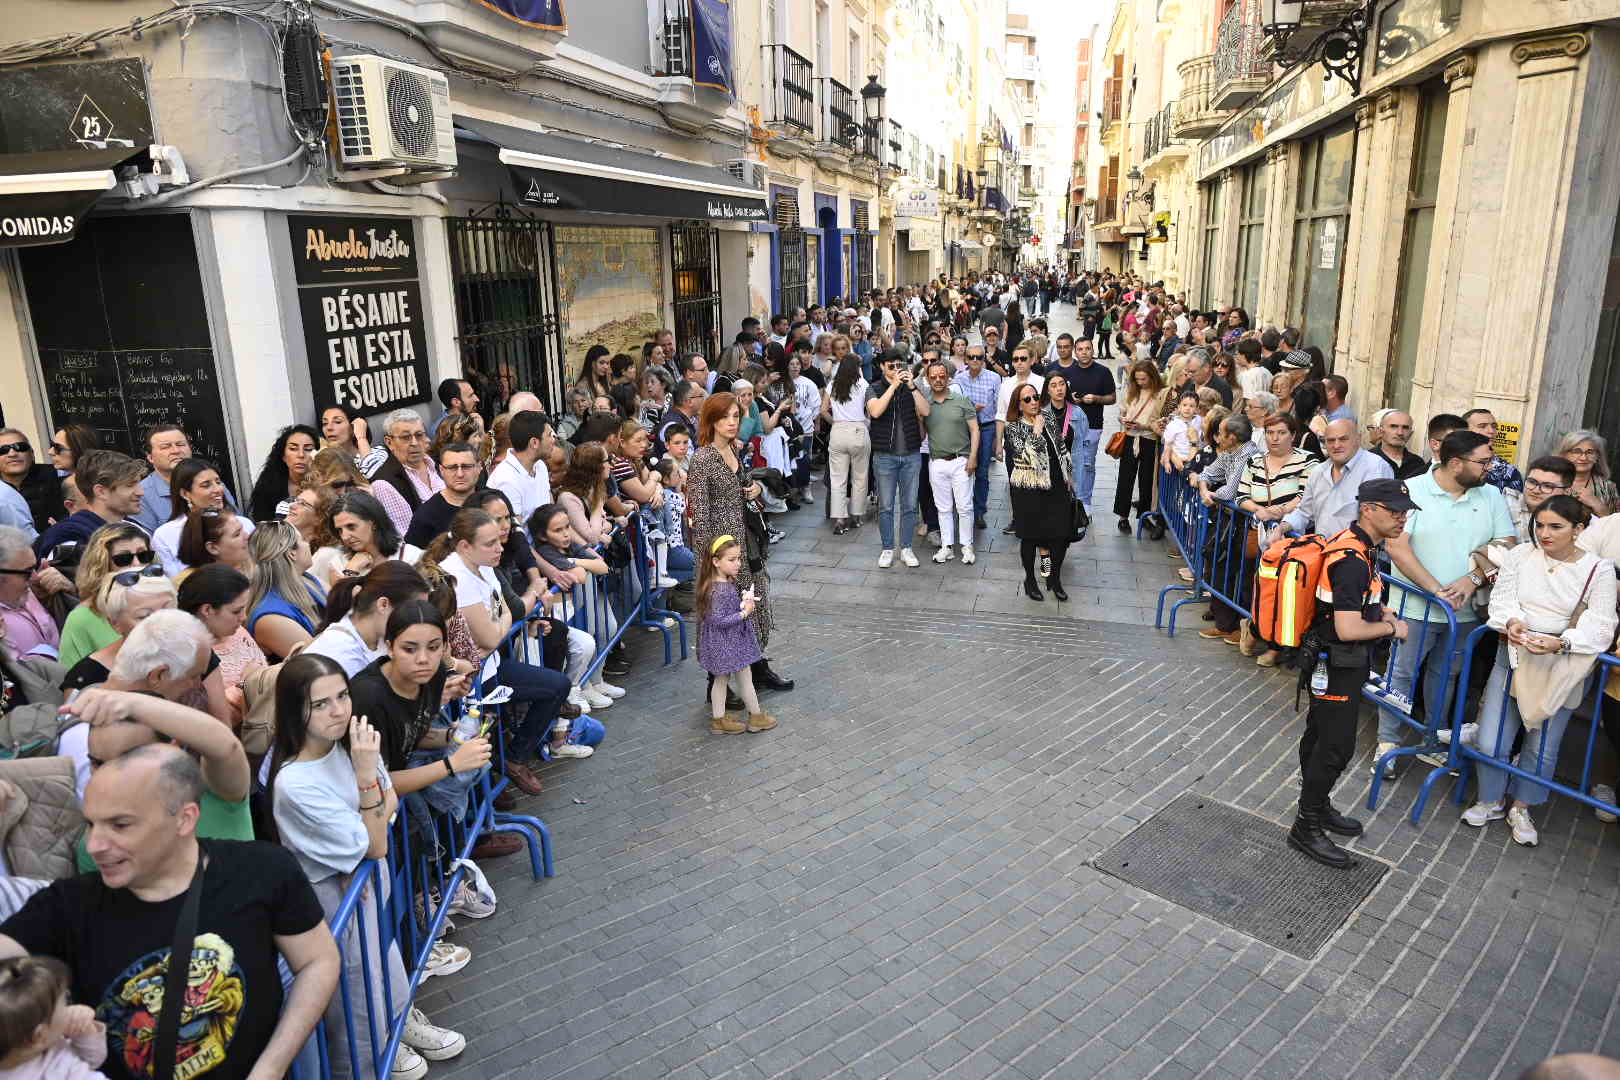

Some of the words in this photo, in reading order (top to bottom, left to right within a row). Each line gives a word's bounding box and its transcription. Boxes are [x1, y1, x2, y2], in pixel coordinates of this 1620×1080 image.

[82, 116, 101, 139] 25
[0, 215, 75, 237] OMIDAS
[306, 228, 368, 261] Abuela
[366, 228, 410, 260] Justa
[321, 288, 411, 333] BÉSAME
[327, 336, 361, 374] EN
[364, 329, 416, 368] ESTA
[333, 365, 420, 410] ESQUINA
